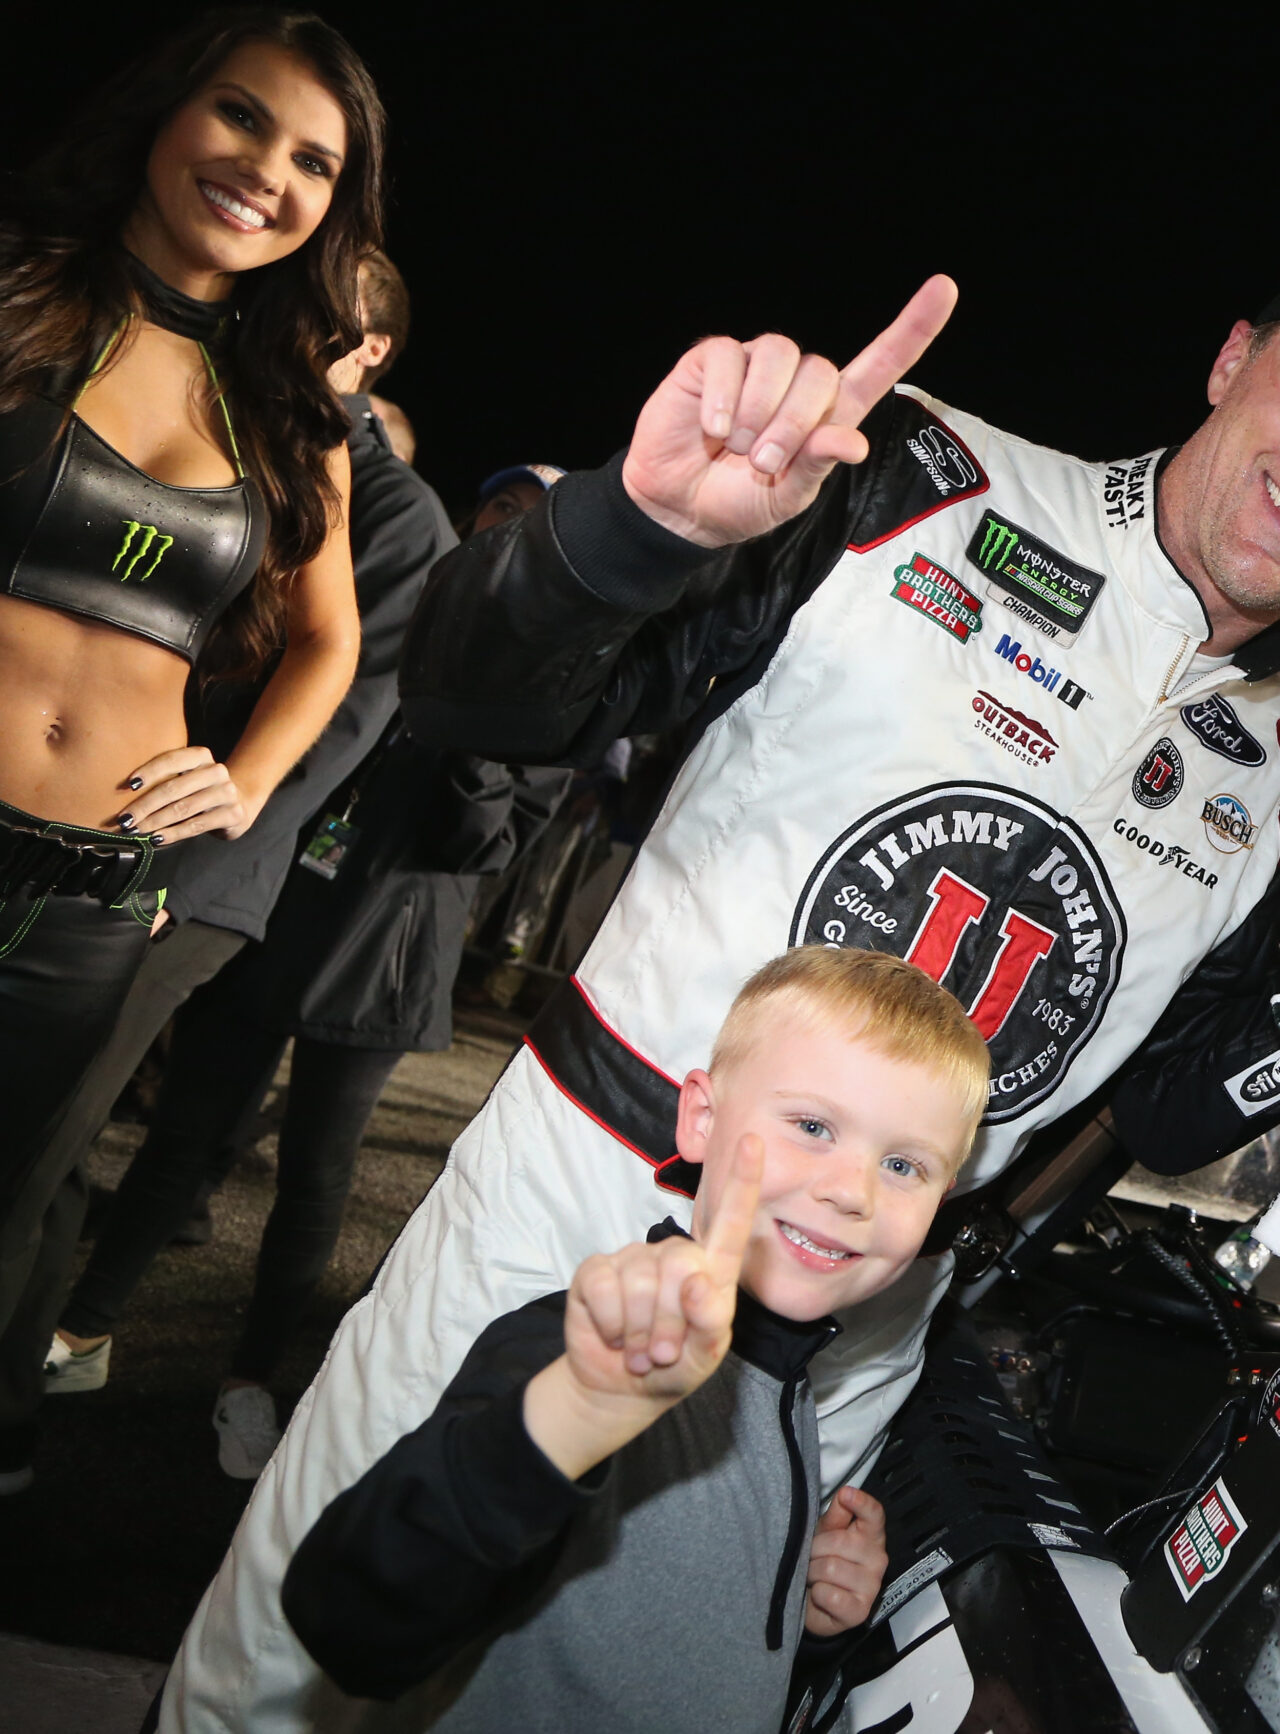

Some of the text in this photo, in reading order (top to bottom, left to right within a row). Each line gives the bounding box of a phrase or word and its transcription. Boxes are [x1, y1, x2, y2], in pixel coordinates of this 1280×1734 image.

[906, 438, 951, 495] SIMPSON
[1126, 457, 1153, 520] FREAKY
[925, 566, 970, 600] HUNT
[1016, 572, 1044, 594] NASCAR
[1043, 590, 1059, 602] CUP
[1017, 545, 1091, 597] MONSTER
[1022, 563, 1079, 600] ENERGY
[899, 568, 979, 630] BROTHERS
[911, 590, 958, 629] PIZZA
[1003, 597, 1061, 638] CHAMPION
[994, 633, 1063, 693] Mobil
[971, 697, 1056, 764] OUTBACK
[973, 719, 1035, 766] STEAKHOUSE
[1190, 696, 1242, 753] Ford
[1201, 801, 1254, 844] BUSCH
[1113, 818, 1219, 889] GOODYEAR
[859, 810, 1103, 999] JIMMY JOHN'S
[834, 885, 899, 934] Since
[1031, 998, 1076, 1036] 1983
[988, 1041, 1058, 1097] ICHES
[1246, 1070, 1277, 1098] sfi
[1186, 1506, 1221, 1571] BROTHERS
[1203, 1497, 1230, 1538] HUNT
[1174, 1530, 1201, 1576] PIZZA
[880, 1590, 903, 1612] JUN
[906, 1567, 933, 1589] 2019
